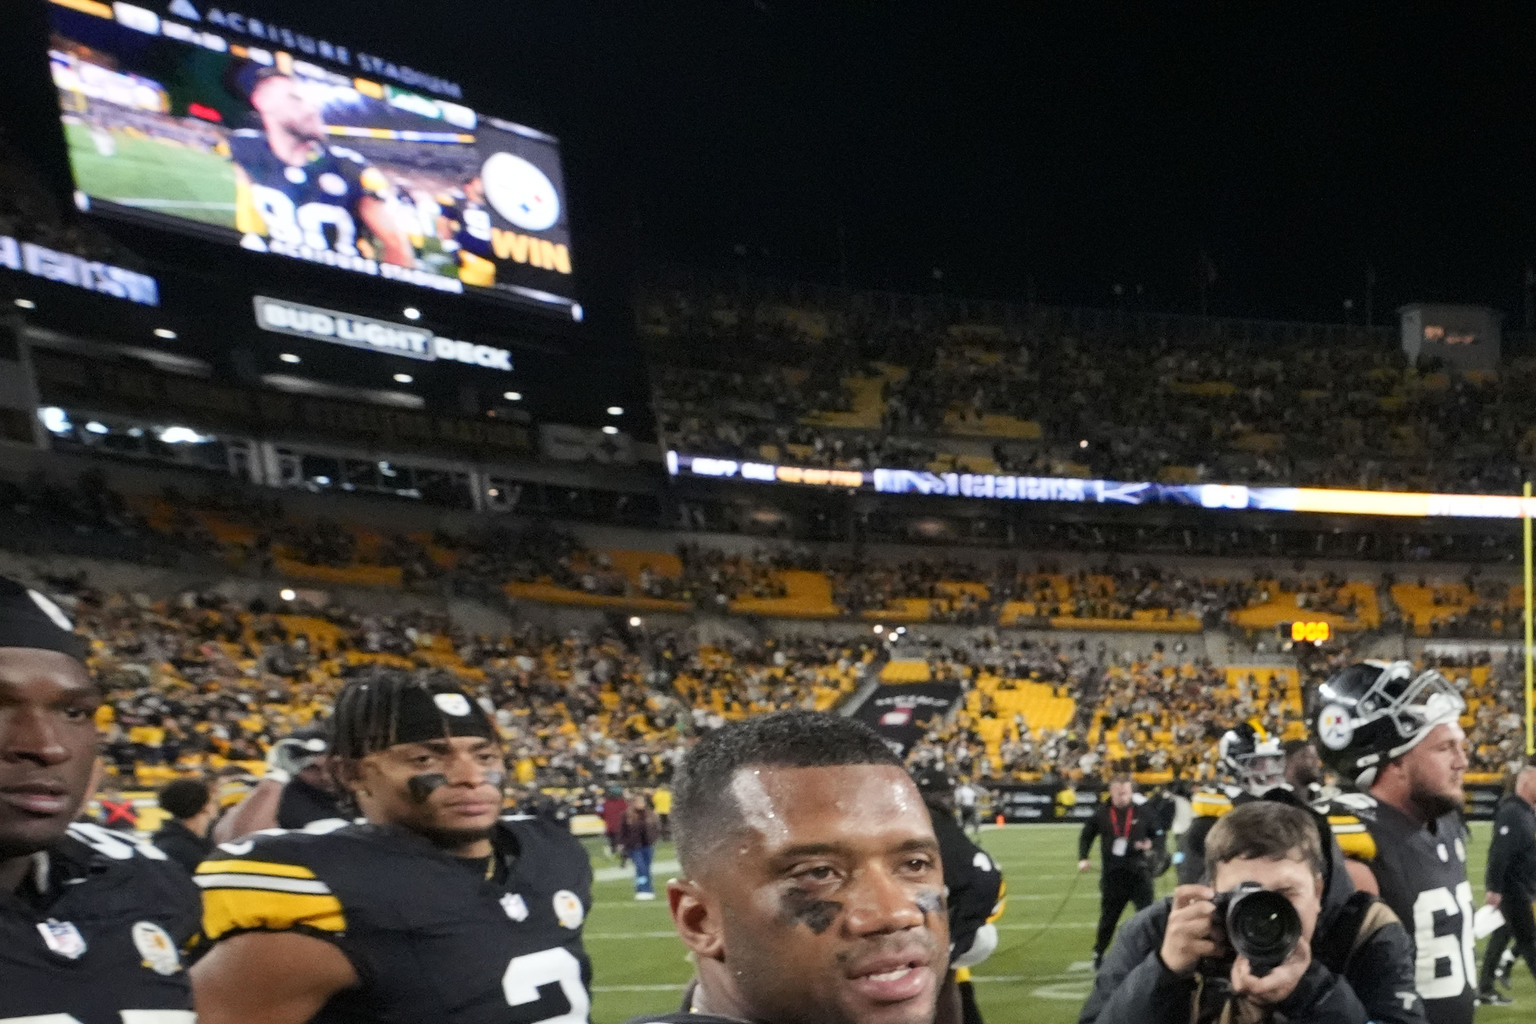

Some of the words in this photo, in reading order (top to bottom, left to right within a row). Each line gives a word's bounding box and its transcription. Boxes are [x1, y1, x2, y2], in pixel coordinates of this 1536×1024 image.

[491, 227, 572, 275] WIN
[263, 303, 335, 335] BUD
[336, 318, 429, 354] LIGHT
[432, 336, 515, 372] DECK
